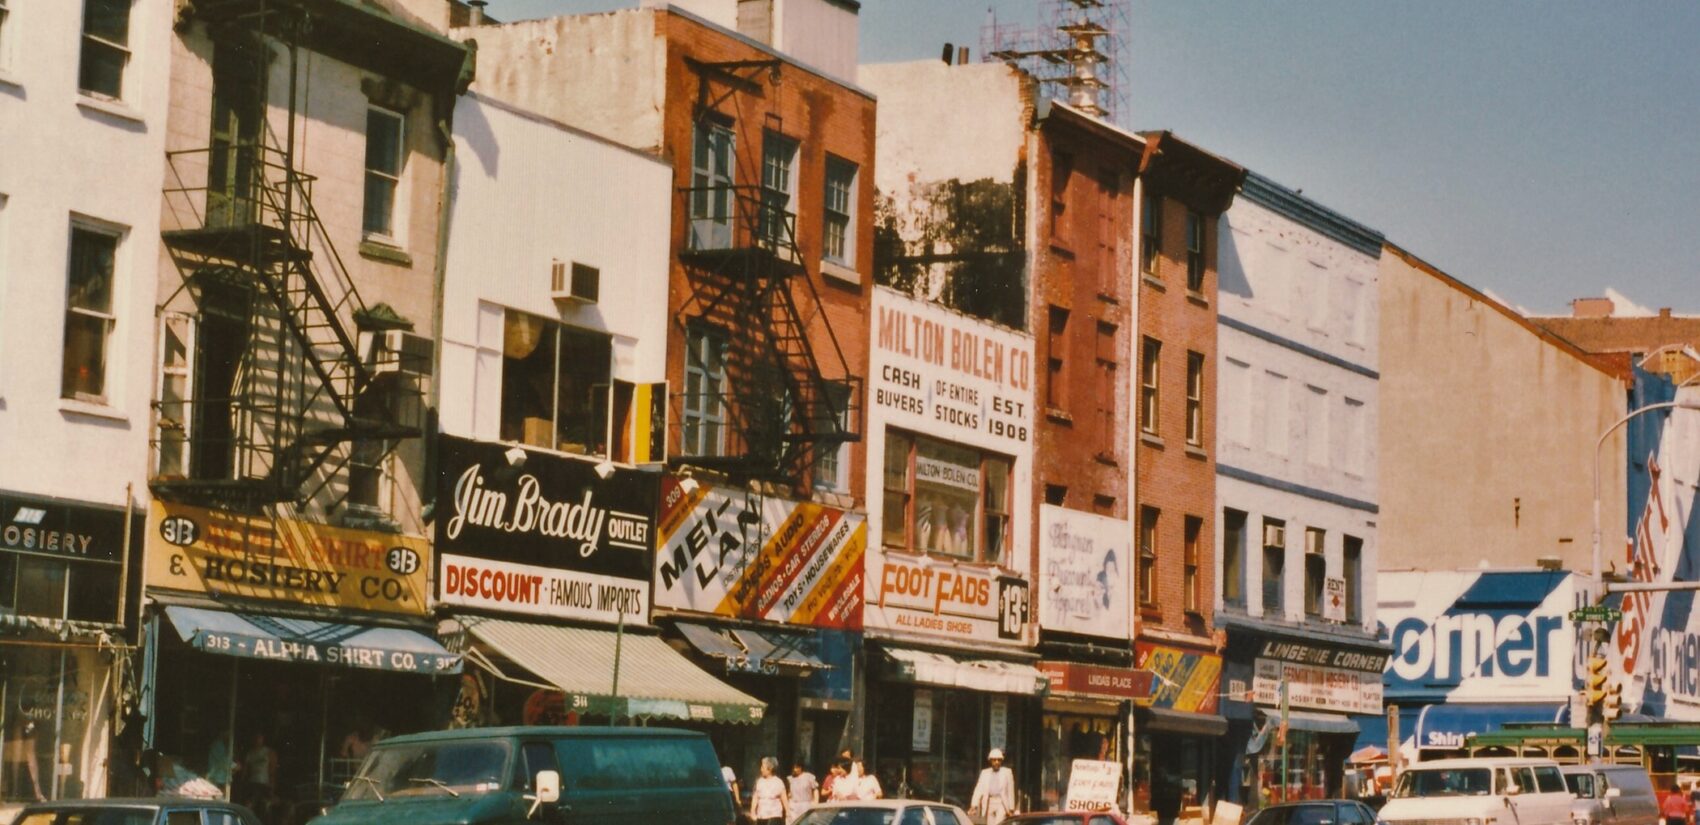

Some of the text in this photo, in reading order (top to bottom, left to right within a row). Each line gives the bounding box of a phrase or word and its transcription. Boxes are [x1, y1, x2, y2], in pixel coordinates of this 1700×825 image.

[878, 306, 945, 367] MILTON
[951, 327, 1004, 384] BOLEN
[882, 364, 921, 390] CASH
[876, 388, 924, 415] BUYERS
[936, 379, 978, 406] OF ENTIRE
[935, 404, 978, 430] STOCKS
[989, 418, 1027, 442] 1908
[943, 467, 965, 484] BOLEN
[447, 463, 507, 540] Jim
[504, 474, 605, 558] Brady
[608, 517, 648, 543] OUTLET
[666, 486, 681, 508] 309
[774, 513, 804, 556] AUDIO
[758, 514, 830, 611] RADIOS CAR STEREOS
[783, 520, 850, 611] TOYS HOUSEWARES
[169, 553, 408, 601] & HOSIERY CO.
[446, 565, 641, 615] DISCOUNT FAMOUS IMPORTS
[879, 564, 990, 616] FOOT FADS
[896, 614, 973, 634] ALL LADIES SHOES
[207, 634, 230, 649] 313
[254, 639, 319, 662] ALPHA
[326, 646, 384, 666] SHIRT
[391, 652, 417, 670] CO.
[1263, 642, 1384, 670] LINGERIE CORNER
[1112, 675, 1132, 689] PLACE
[573, 695, 588, 708] 311
[1428, 731, 1465, 746] Shirt
